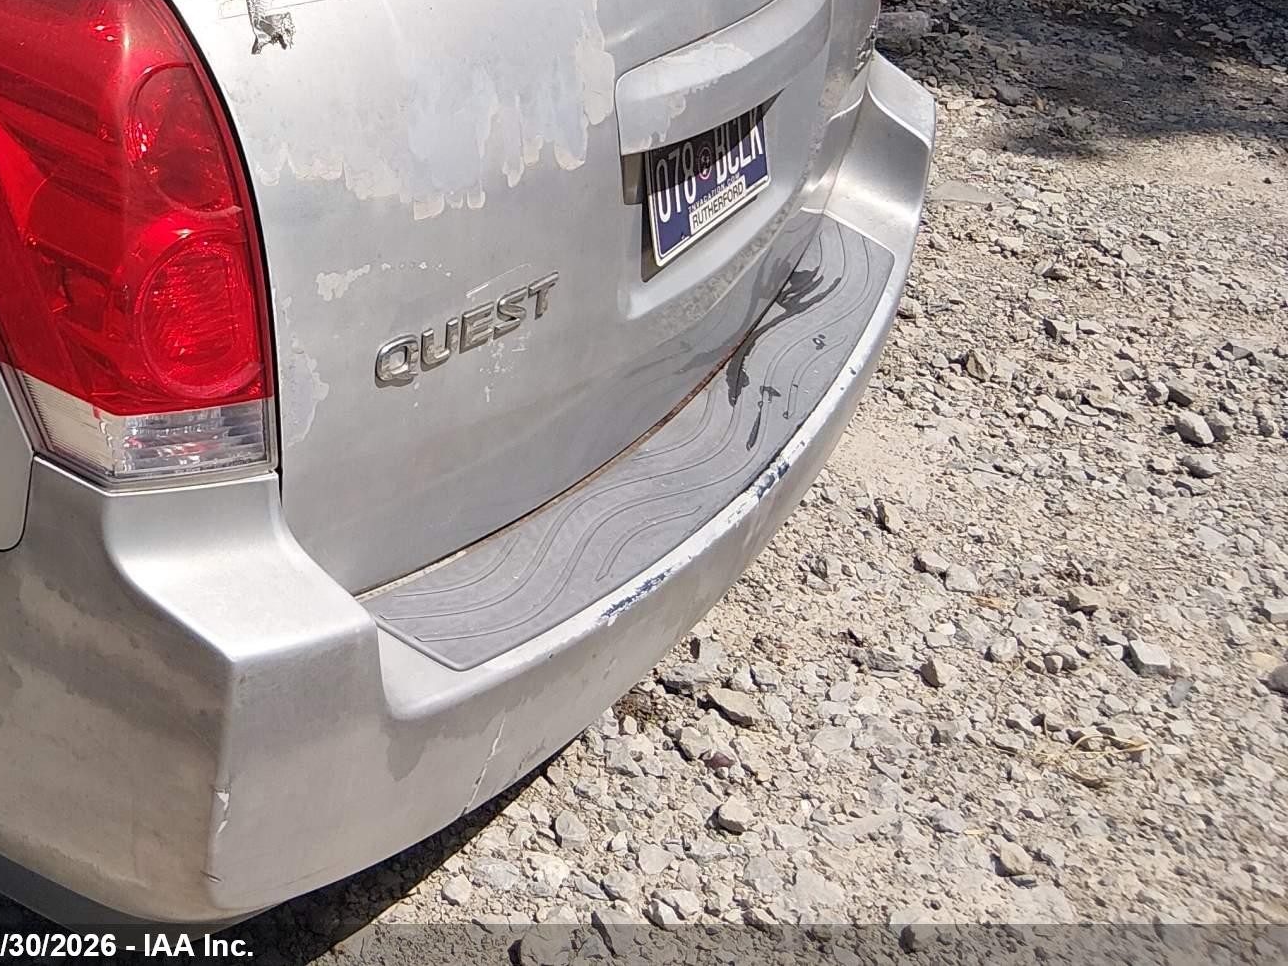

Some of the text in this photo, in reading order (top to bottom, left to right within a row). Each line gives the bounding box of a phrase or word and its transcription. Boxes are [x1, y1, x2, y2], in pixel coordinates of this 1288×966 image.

[656, 141, 698, 224] 078
[692, 181, 744, 229] RUTHERFORD
[375, 270, 560, 388] QUEST
